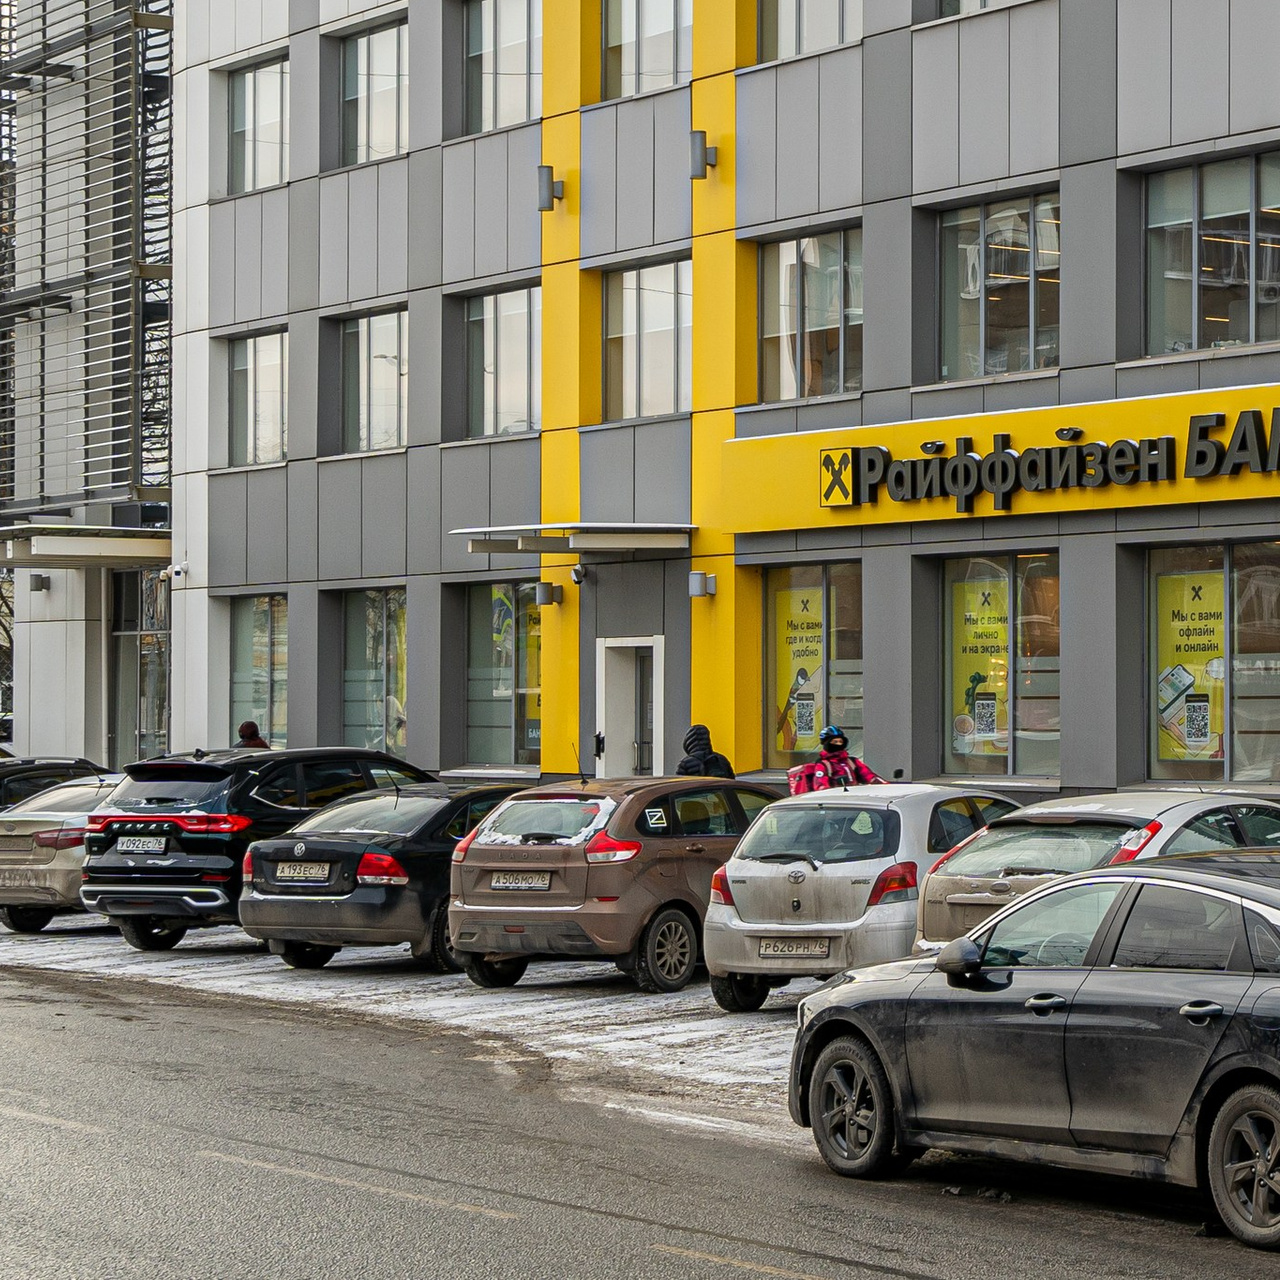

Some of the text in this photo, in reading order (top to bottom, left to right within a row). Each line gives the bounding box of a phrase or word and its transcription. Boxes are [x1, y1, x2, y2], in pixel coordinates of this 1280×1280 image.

[858, 426, 1176, 513] Райффайзен
[964, 614, 1008, 625] Мы с вами
[1171, 610, 1223, 622] Мы с вами
[786, 620, 799, 630] Мы
[800, 622, 805, 630] с
[973, 631, 998, 639] лично
[1178, 624, 1215, 640] офлайн
[785, 636, 797, 645] где
[805, 635, 823, 645] когд
[961, 645, 967, 654] и
[969, 645, 979, 654] на
[1175, 640, 1219, 652] и онлайн
[792, 646, 819, 660] удобно
[153, 838, 163, 847] 76
[316, 864, 326, 873] 76
[536, 871, 546, 883] 76
[813, 939, 824, 950] 76
